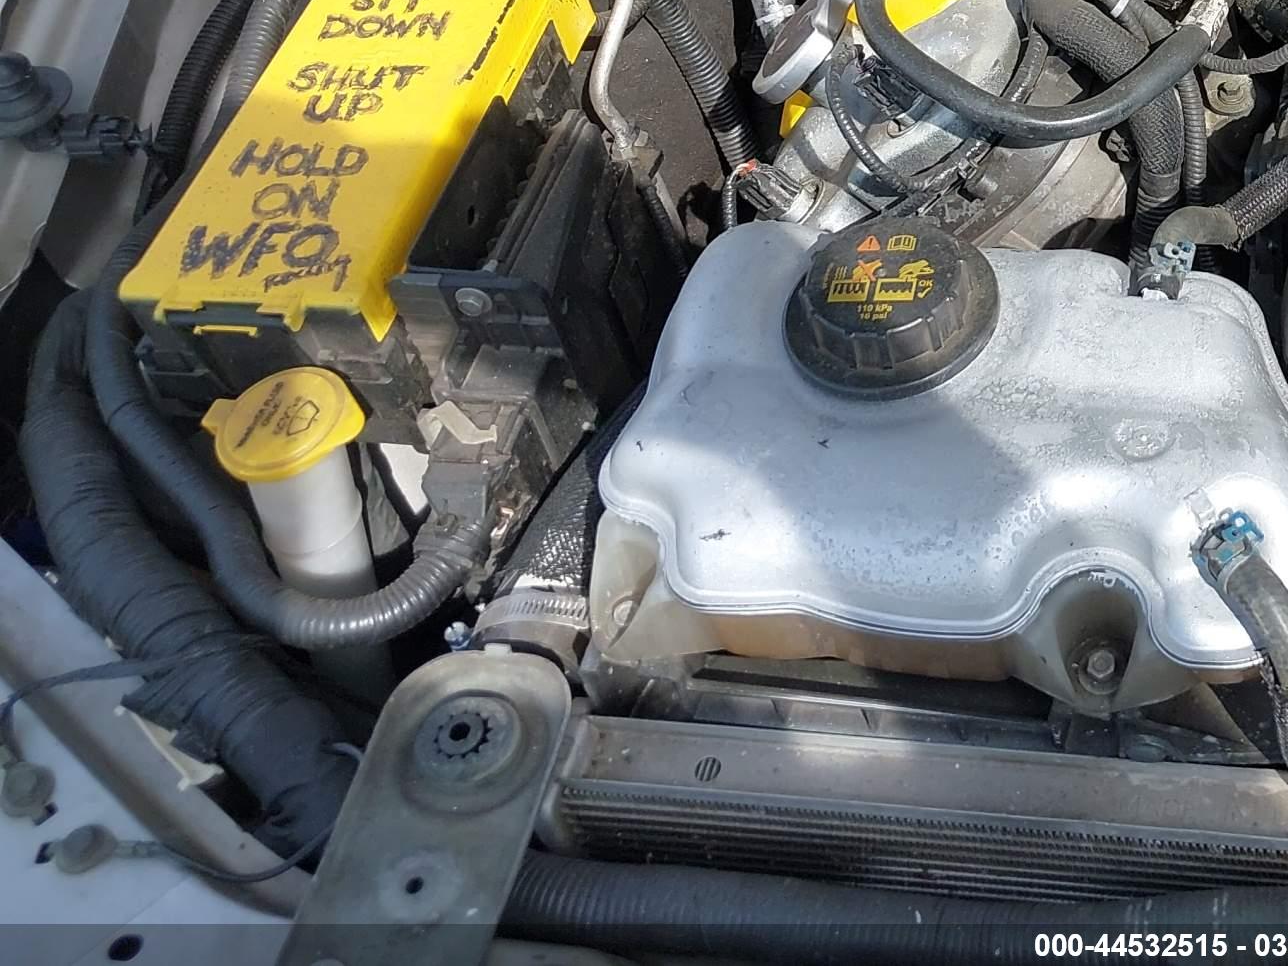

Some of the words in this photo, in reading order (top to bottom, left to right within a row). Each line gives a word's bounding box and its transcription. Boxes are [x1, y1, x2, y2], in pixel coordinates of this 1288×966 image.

[317, 10, 453, 40] DOWN
[287, 61, 428, 92] SHUT
[303, 92, 384, 124] UP
[228, 137, 370, 178] HOLD
[252, 178, 341, 221] ON
[178, 221, 341, 279] WFO
[857, 304, 874, 313] 110
[875, 304, 893, 313] kPa
